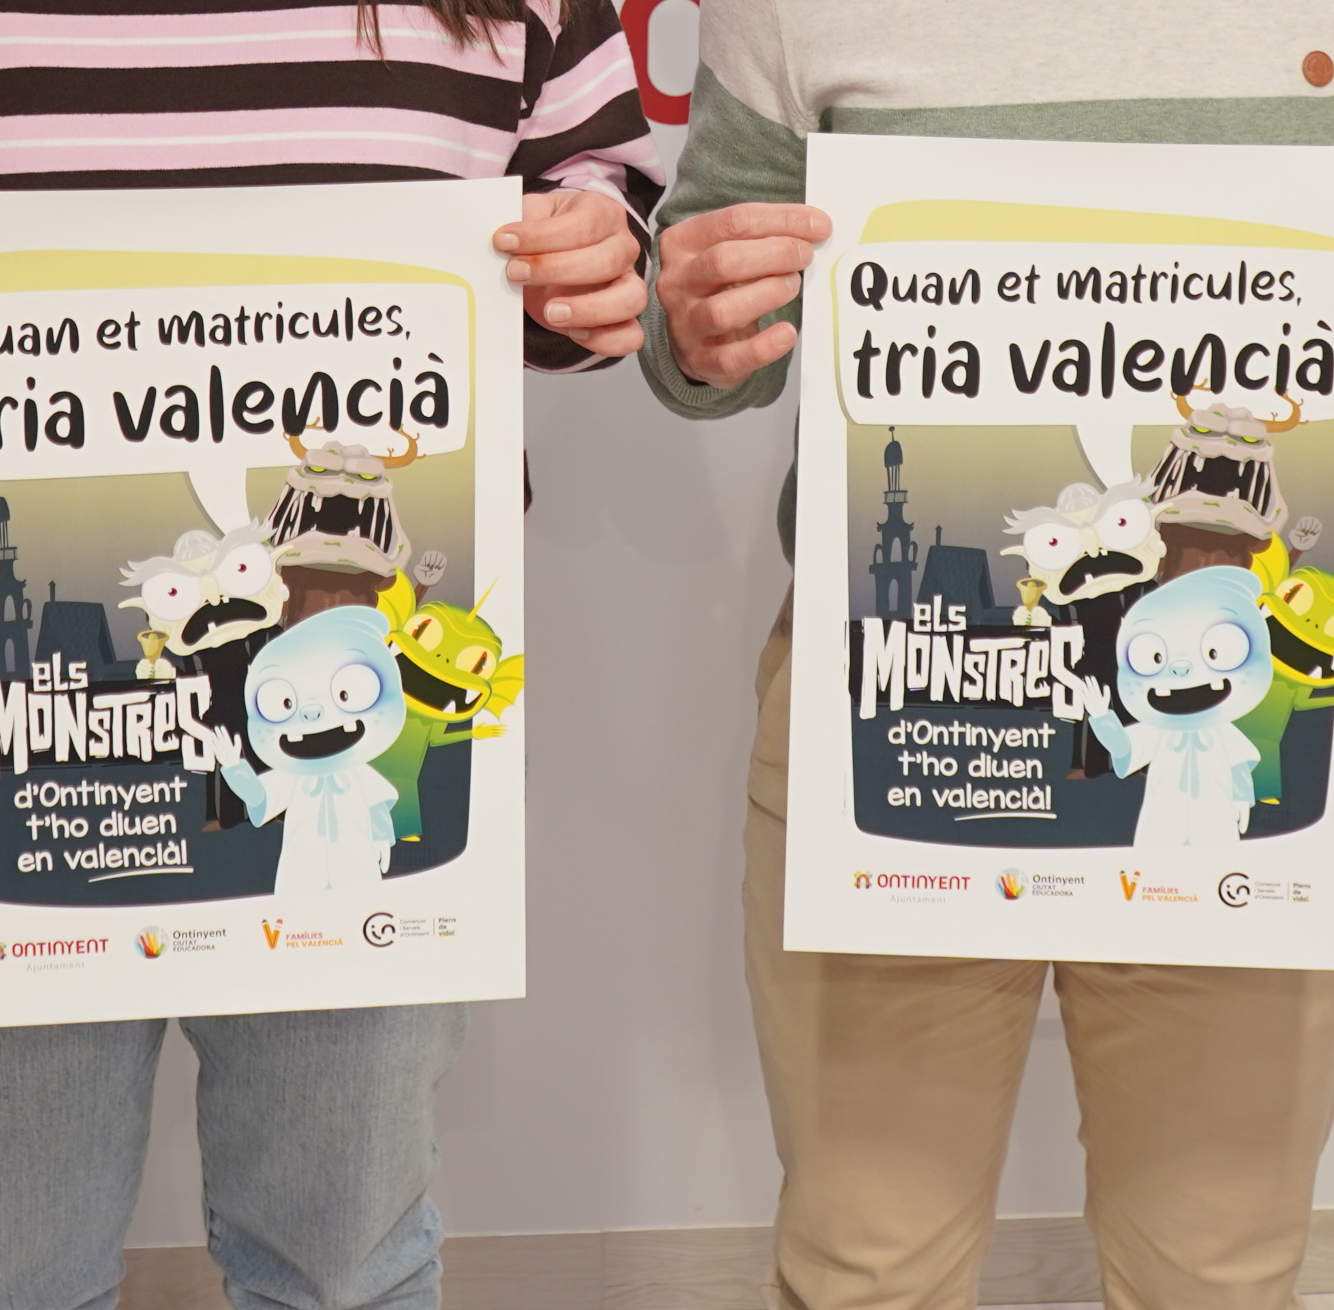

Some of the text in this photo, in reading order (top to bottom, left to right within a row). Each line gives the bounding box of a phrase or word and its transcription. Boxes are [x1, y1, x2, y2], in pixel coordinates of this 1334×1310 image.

[850, 260, 1302, 311] Quan et matricules,
[96, 310, 140, 351] et
[158, 296, 411, 346] matricules,
[853, 319, 1334, 399] tria valencià
[112, 352, 449, 444] valencià
[888, 719, 1056, 752] d'Ontinyent
[897, 752, 1043, 779] t'ho diuen
[13, 775, 188, 810] d'Ontinyent
[887, 783, 1052, 811] en valencià!
[25, 810, 177, 840] t'ho diuen
[17, 839, 188, 873] en valencià!
[877, 873, 971, 890] ONTINYENT
[1032, 874, 1085, 886] Ontinyent
[12, 938, 109, 958] ONTINYENT
[173, 928, 227, 940] Ontinyent
